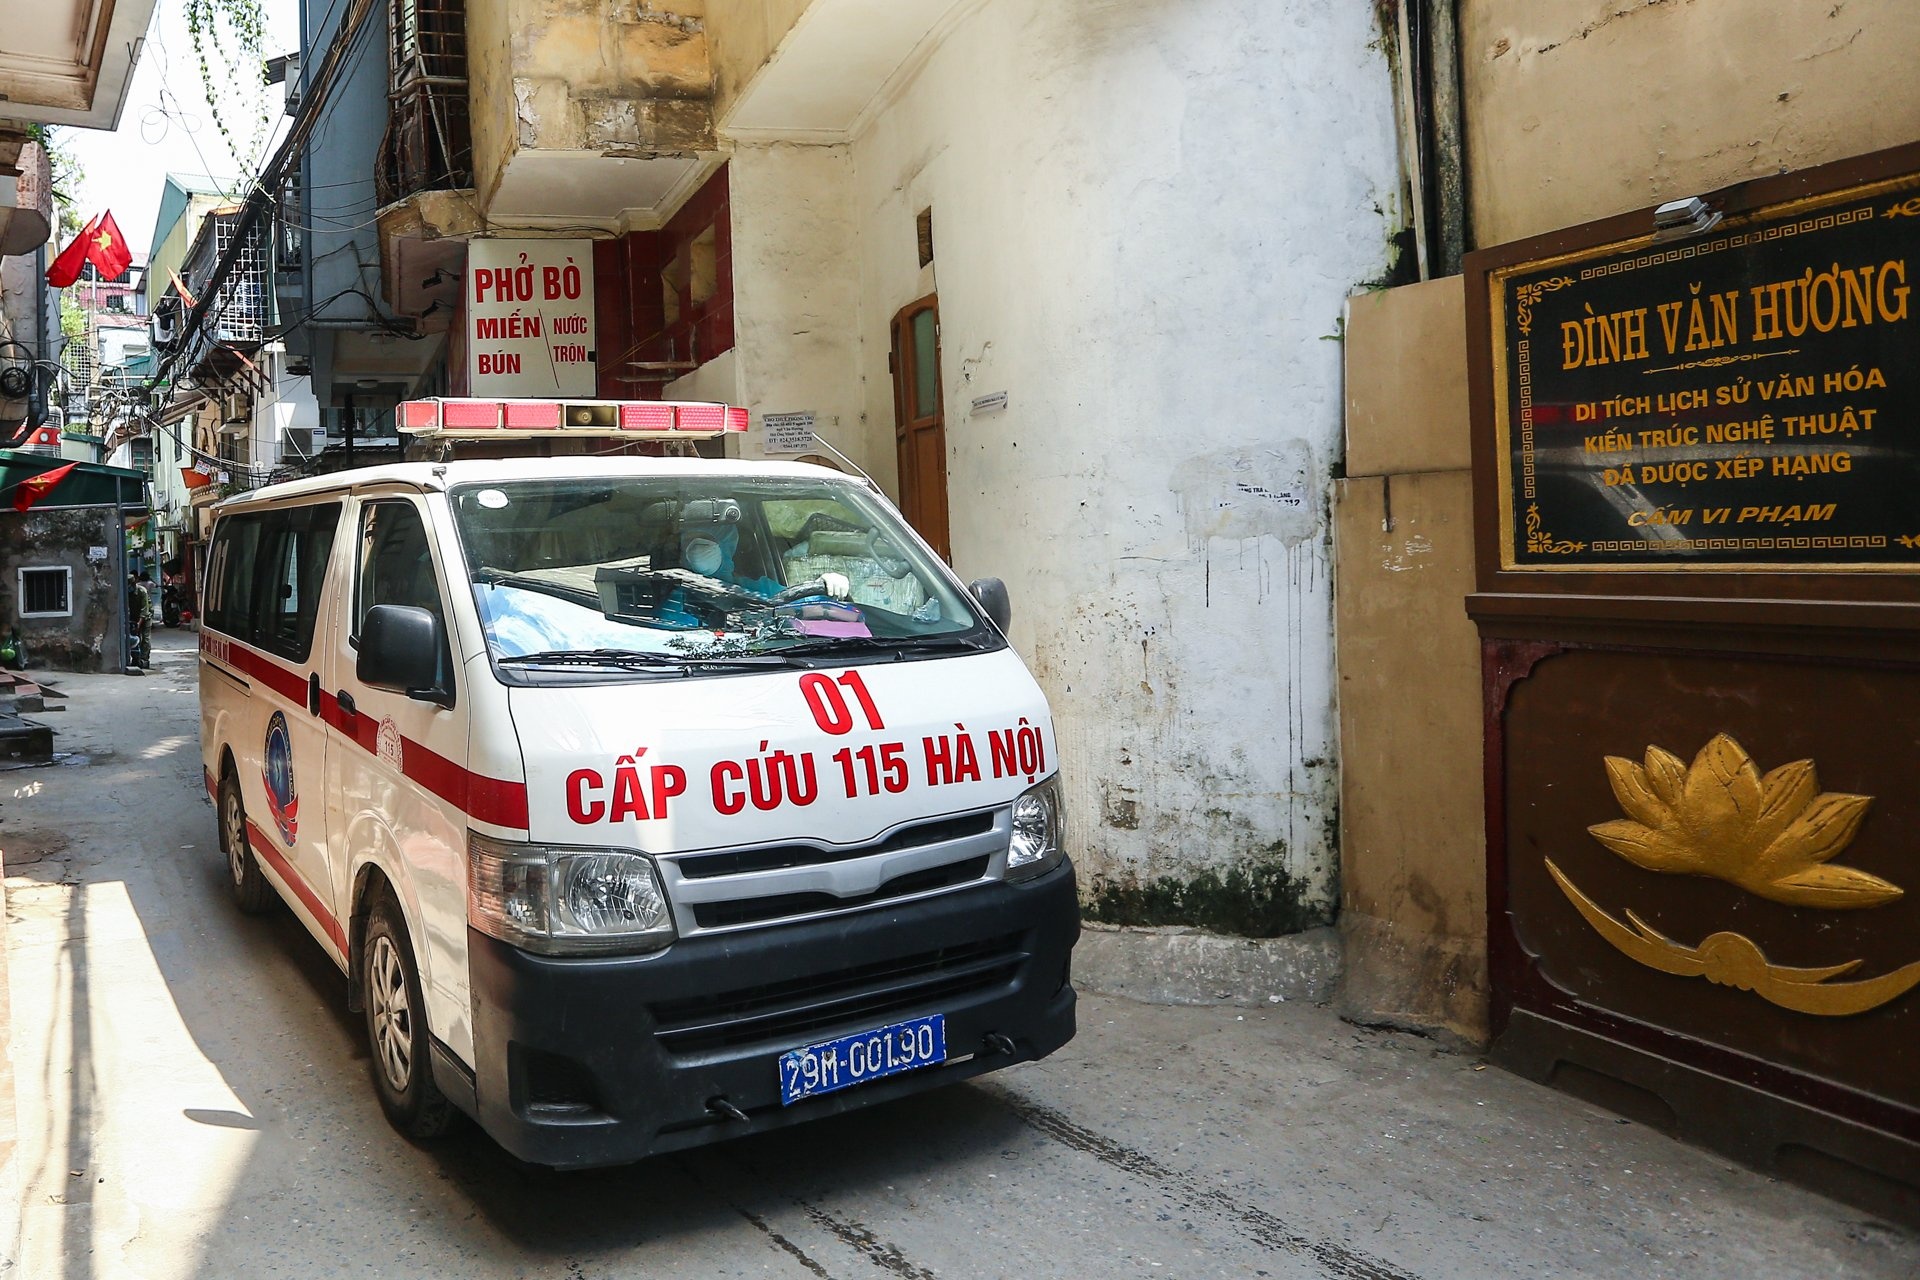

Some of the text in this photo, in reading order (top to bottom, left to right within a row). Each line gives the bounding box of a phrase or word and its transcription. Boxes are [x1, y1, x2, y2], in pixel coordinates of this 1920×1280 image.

[475, 252, 581, 303] PHỞ BÒ
[476, 308, 540, 339] MIẾN
[553, 313, 588, 334] NƯỚC
[1561, 259, 1911, 370] ĐÌNH VĂN HƯƠNG
[478, 350, 521, 374] BÚN
[553, 343, 586, 365] TRỘN
[1575, 364, 1887, 421] DI TÍCH LỊCH SỬ VĂN HÓA
[1584, 406, 1877, 454] KIẾN TRÚC NGHỆ THUẬT
[1603, 451, 1851, 487] ĐÃ ĐƯỢC XẾP HẠNG
[1627, 503, 1837, 527] CẤM VI PHẠM
[799, 670, 885, 735] 01
[566, 717, 1045, 824] CẤP CỨU 115 HÀ NỘI
[785, 1024, 934, 1098] 29M-001.90
